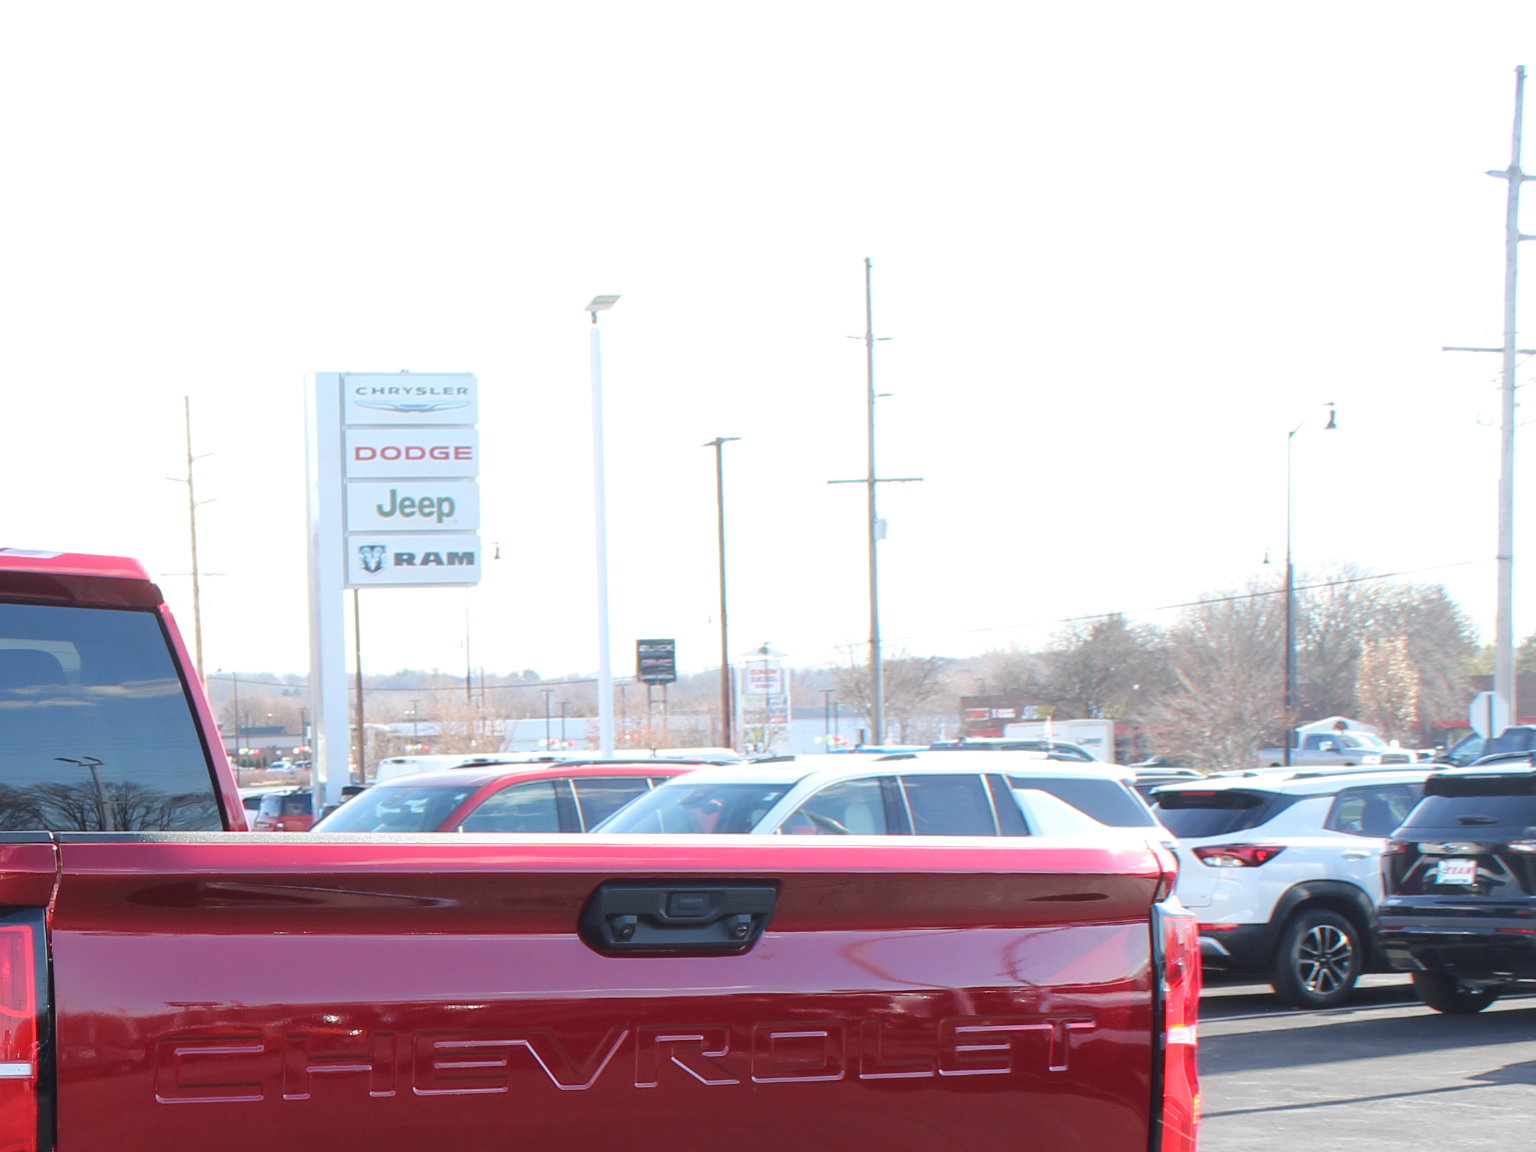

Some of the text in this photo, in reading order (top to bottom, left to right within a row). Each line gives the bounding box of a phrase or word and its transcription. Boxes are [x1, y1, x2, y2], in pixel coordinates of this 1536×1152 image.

[355, 386, 469, 396] CHRYSLER
[354, 446, 473, 461] DODGE
[376, 488, 456, 524] Jeep
[393, 551, 475, 567] RAM
[154, 1012, 1097, 1103] CHEVROLET
